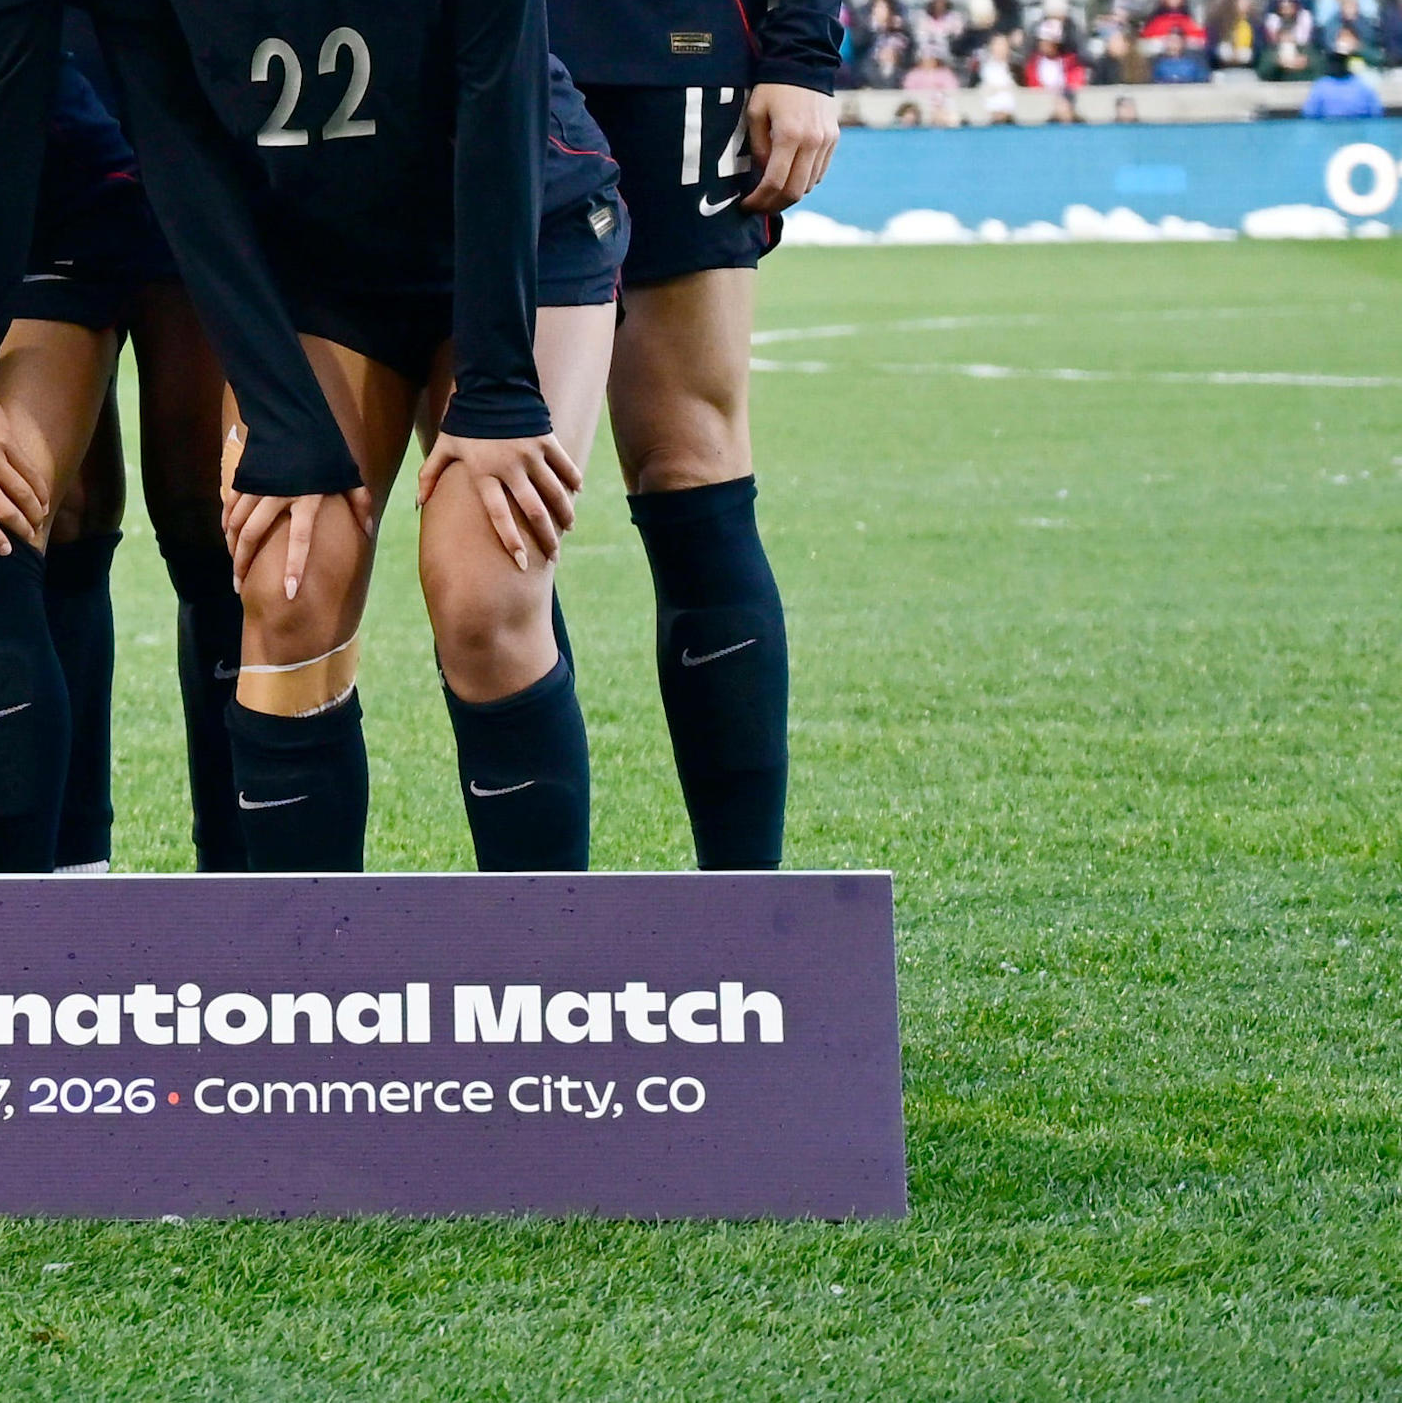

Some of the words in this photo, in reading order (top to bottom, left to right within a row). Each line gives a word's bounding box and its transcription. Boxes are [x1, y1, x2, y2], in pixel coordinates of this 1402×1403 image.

[251, 26, 376, 146] 22
[453, 982, 784, 1044] Match
[28, 1077, 156, 1114] 2026
[194, 1078, 494, 1114] Commerce
[508, 1075, 624, 1119] City,
[636, 1076, 706, 1113] CO
